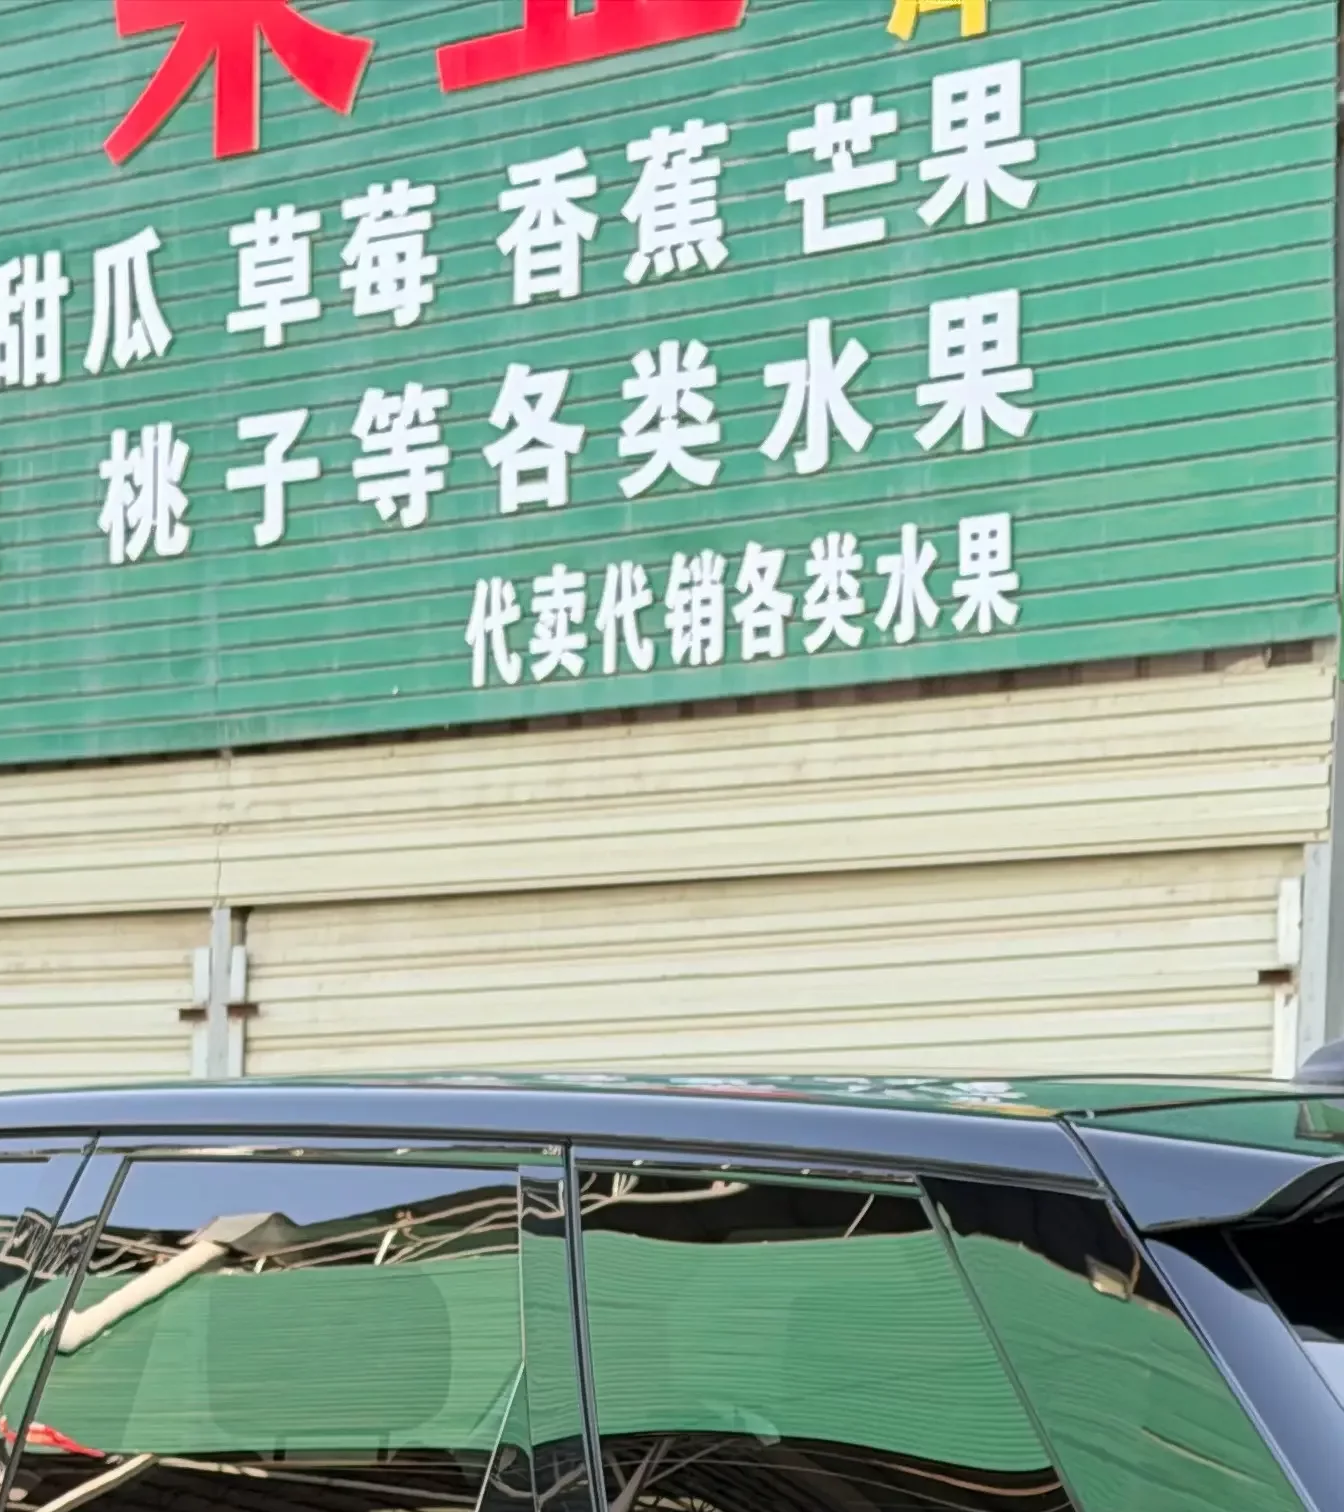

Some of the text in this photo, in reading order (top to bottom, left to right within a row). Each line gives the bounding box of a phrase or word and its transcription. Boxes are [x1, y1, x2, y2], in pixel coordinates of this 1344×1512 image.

[227, 180, 439, 347] 草莓
[496, 119, 729, 305] 香蕉
[784, 59, 1037, 254] 芒果
[99, 287, 1034, 566] 桃子等各类水果
[466, 512, 1020, 688] 代卖代销各类水果
